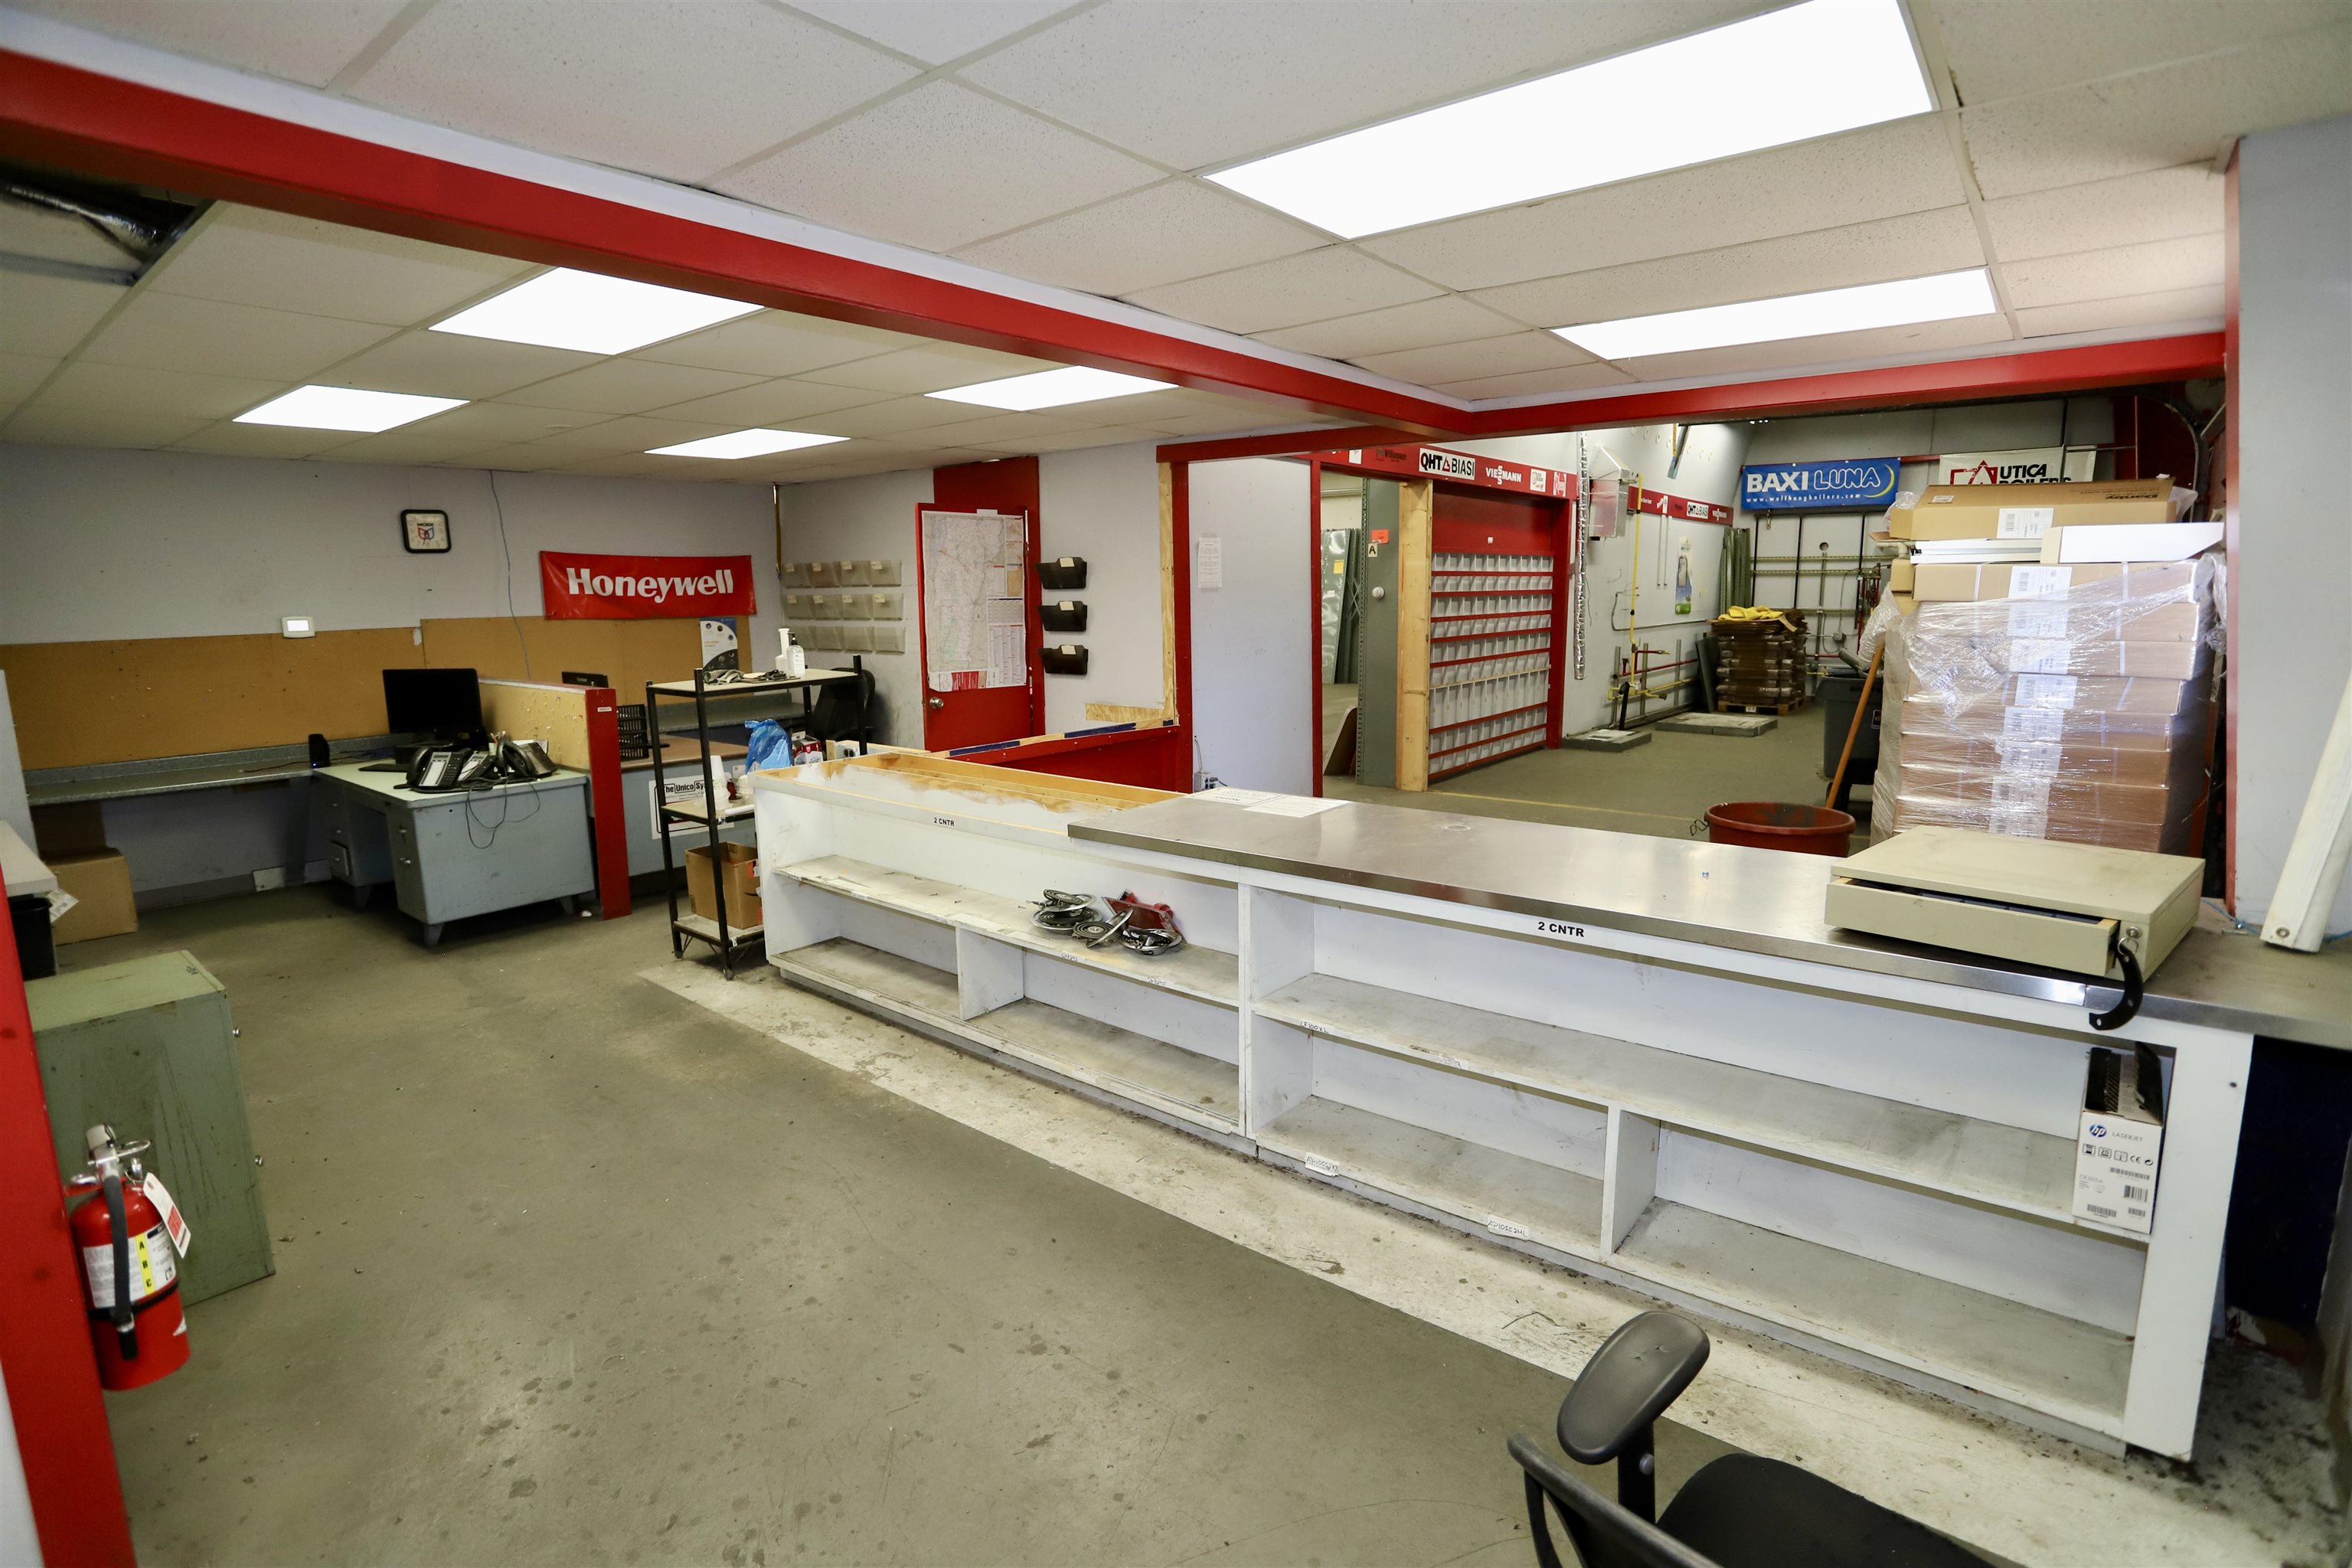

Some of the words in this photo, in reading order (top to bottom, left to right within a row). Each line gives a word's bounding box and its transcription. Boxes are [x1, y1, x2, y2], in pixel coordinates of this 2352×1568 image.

[1420, 452, 1442, 471] QHT
[1452, 458, 1475, 476] BIASI
[1485, 466, 1522, 485] VIESSMANN
[2000, 463, 2047, 479] UTICA
[1746, 471, 1809, 493] BAXI
[1813, 467, 1881, 490] LUNA
[1746, 493, 1860, 503] www.wallhungboilers.com
[1369, 545, 1376, 554] A
[566, 567, 733, 603] Honeywell
[664, 785, 674, 793] he
[939, 818, 955, 827] CNTR
[1538, 922, 1545, 930] 2
[1549, 923, 1584, 937] CNTR
[2112, 1132, 2143, 1142] LASERJET
[139, 1241, 145, 1250] A
[142, 1260, 148, 1269] B
[146, 1279, 152, 1288] C
